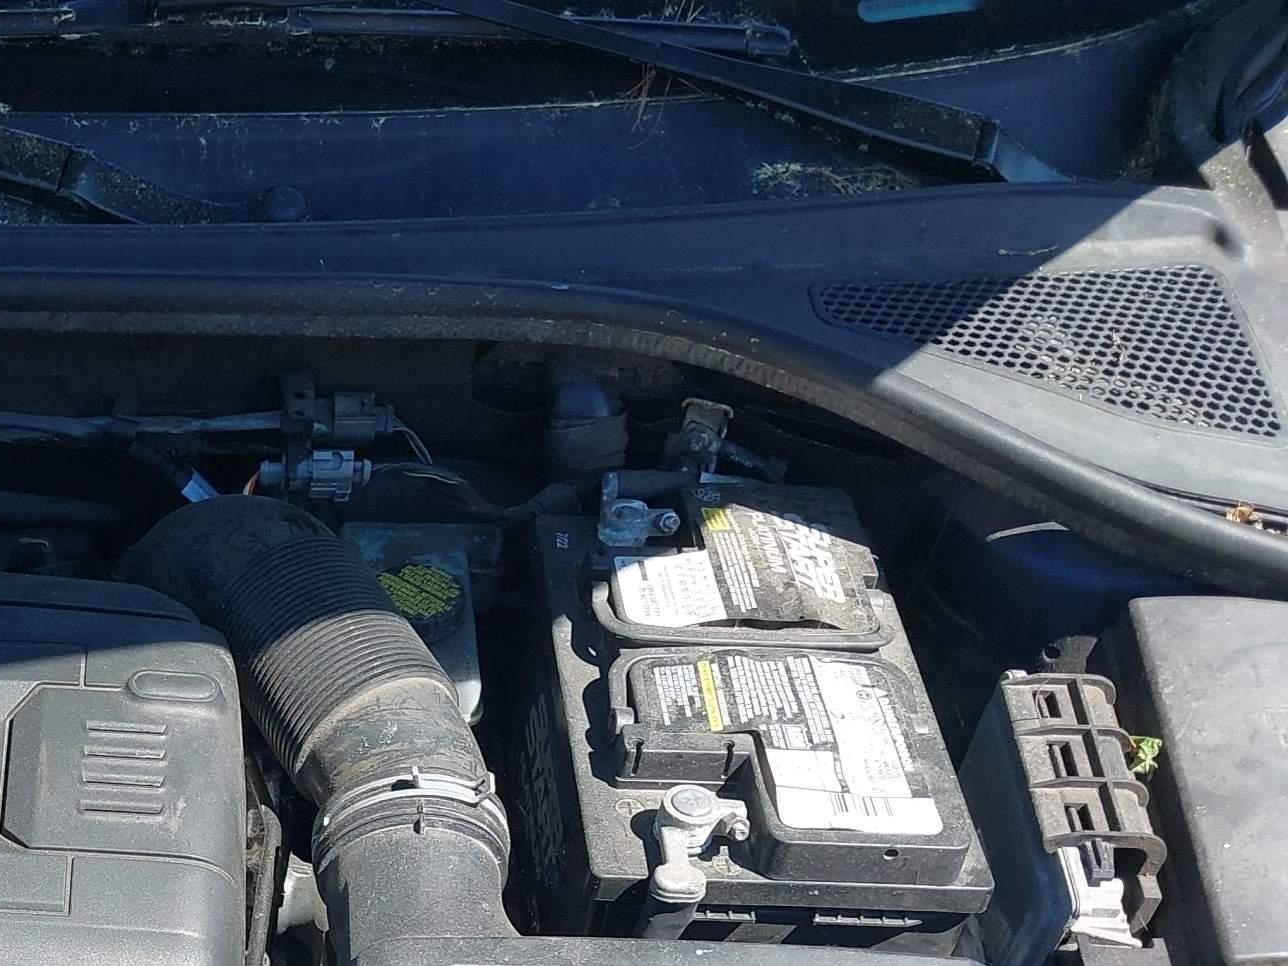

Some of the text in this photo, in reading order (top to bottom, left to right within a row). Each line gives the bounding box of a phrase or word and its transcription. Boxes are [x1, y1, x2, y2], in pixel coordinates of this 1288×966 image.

[745, 511, 787, 574] PLATINUM
[773, 513, 825, 599] START
[808, 523, 846, 603] SUPER
